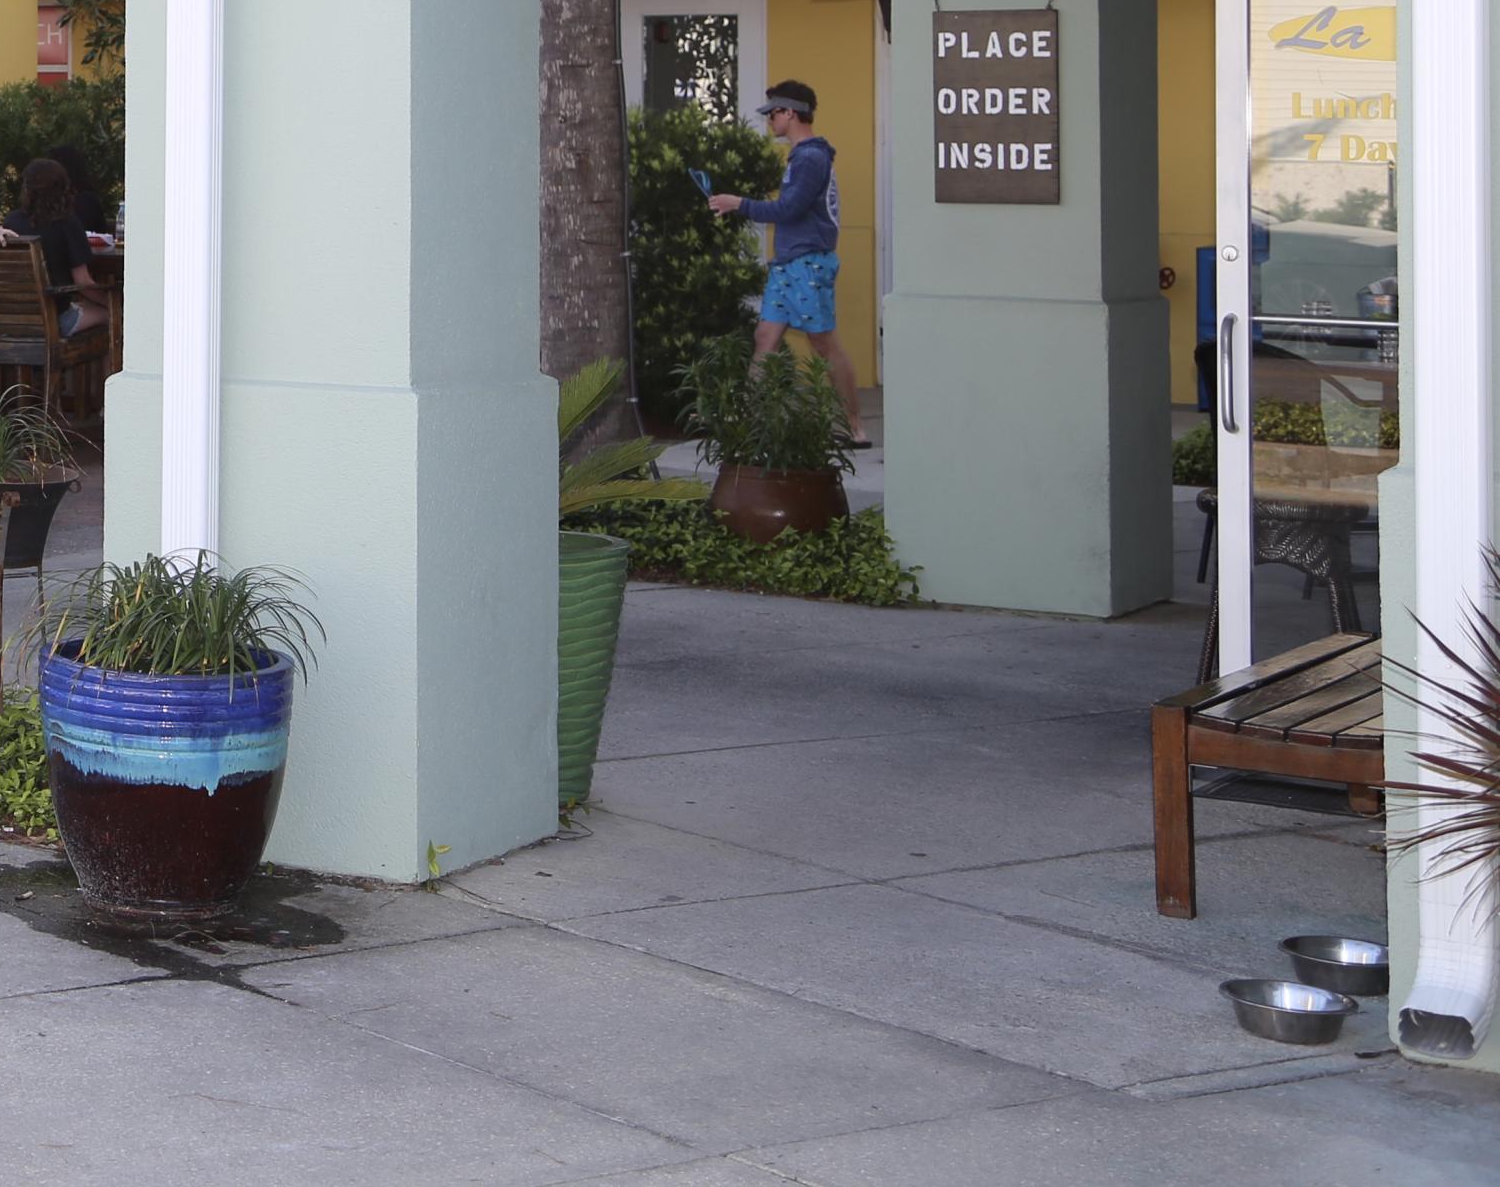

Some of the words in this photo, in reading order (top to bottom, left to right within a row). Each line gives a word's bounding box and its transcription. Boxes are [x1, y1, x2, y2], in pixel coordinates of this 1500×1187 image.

[1274, 5, 1372, 51] La
[937, 29, 1052, 60] PLACE
[937, 86, 1052, 116] ORDER
[1291, 92, 1396, 120] Lunch
[937, 142, 1053, 171] INSIDE
[1303, 133, 1325, 161] 7
